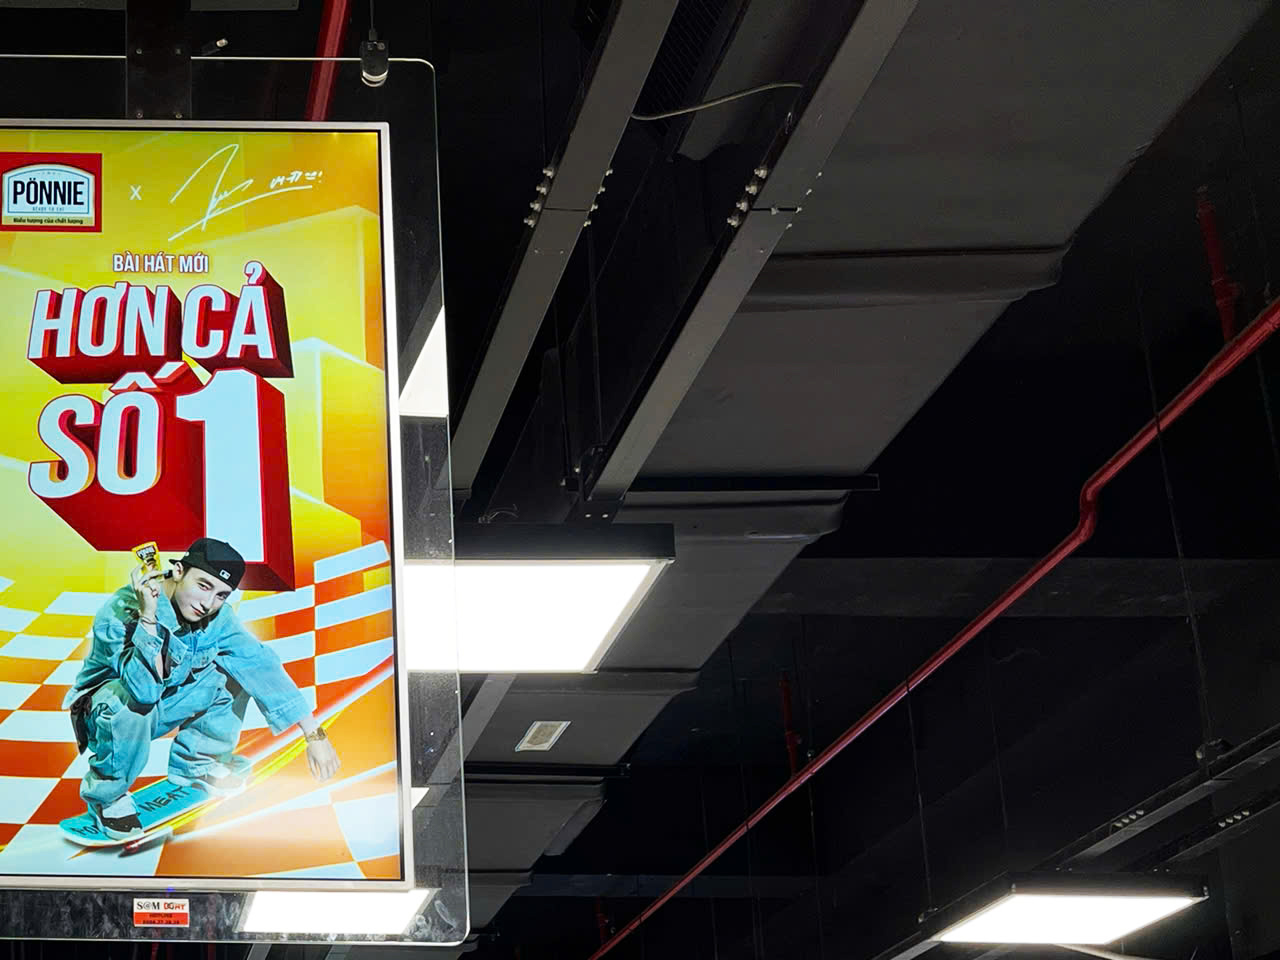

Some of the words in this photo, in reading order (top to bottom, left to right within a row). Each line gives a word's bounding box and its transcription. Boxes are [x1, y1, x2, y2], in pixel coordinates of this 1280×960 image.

[12, 177, 85, 206] PÖNNIE
[113, 250, 140, 273] BÀI
[143, 251, 176, 273] HÁT
[179, 251, 209, 273] MỚI
[26, 281, 173, 360] HƠN
[181, 261, 276, 360] CẢ
[28, 361, 187, 499] SỐ
[176, 368, 265, 562] 1
